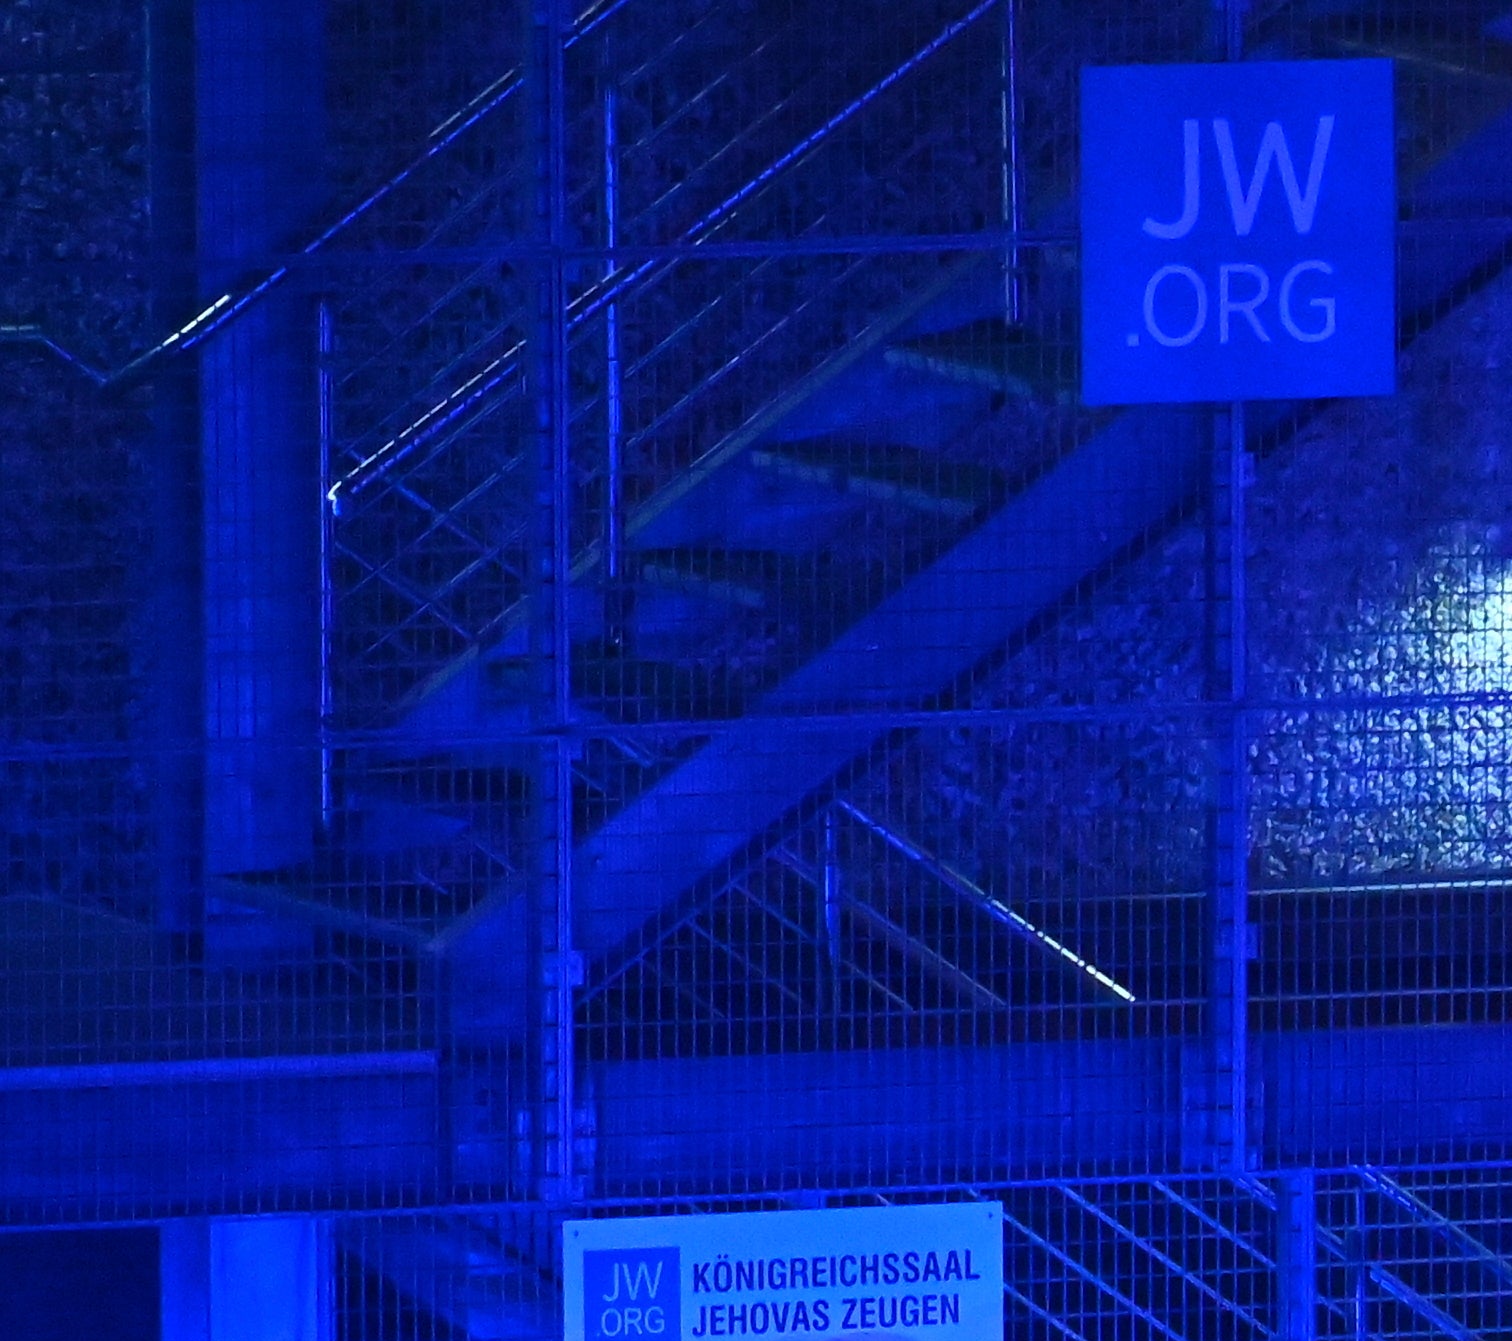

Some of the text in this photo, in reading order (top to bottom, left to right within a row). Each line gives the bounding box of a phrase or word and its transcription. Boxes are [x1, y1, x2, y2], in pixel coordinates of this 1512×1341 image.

[1141, 114, 1336, 240] JW
[1125, 259, 1337, 348] .ORG
[602, 1260, 664, 1302] JW
[692, 1249, 980, 1295] KÖNIGREICHSSAAL
[692, 1293, 961, 1338] JEHOVAS ZEUGEN
